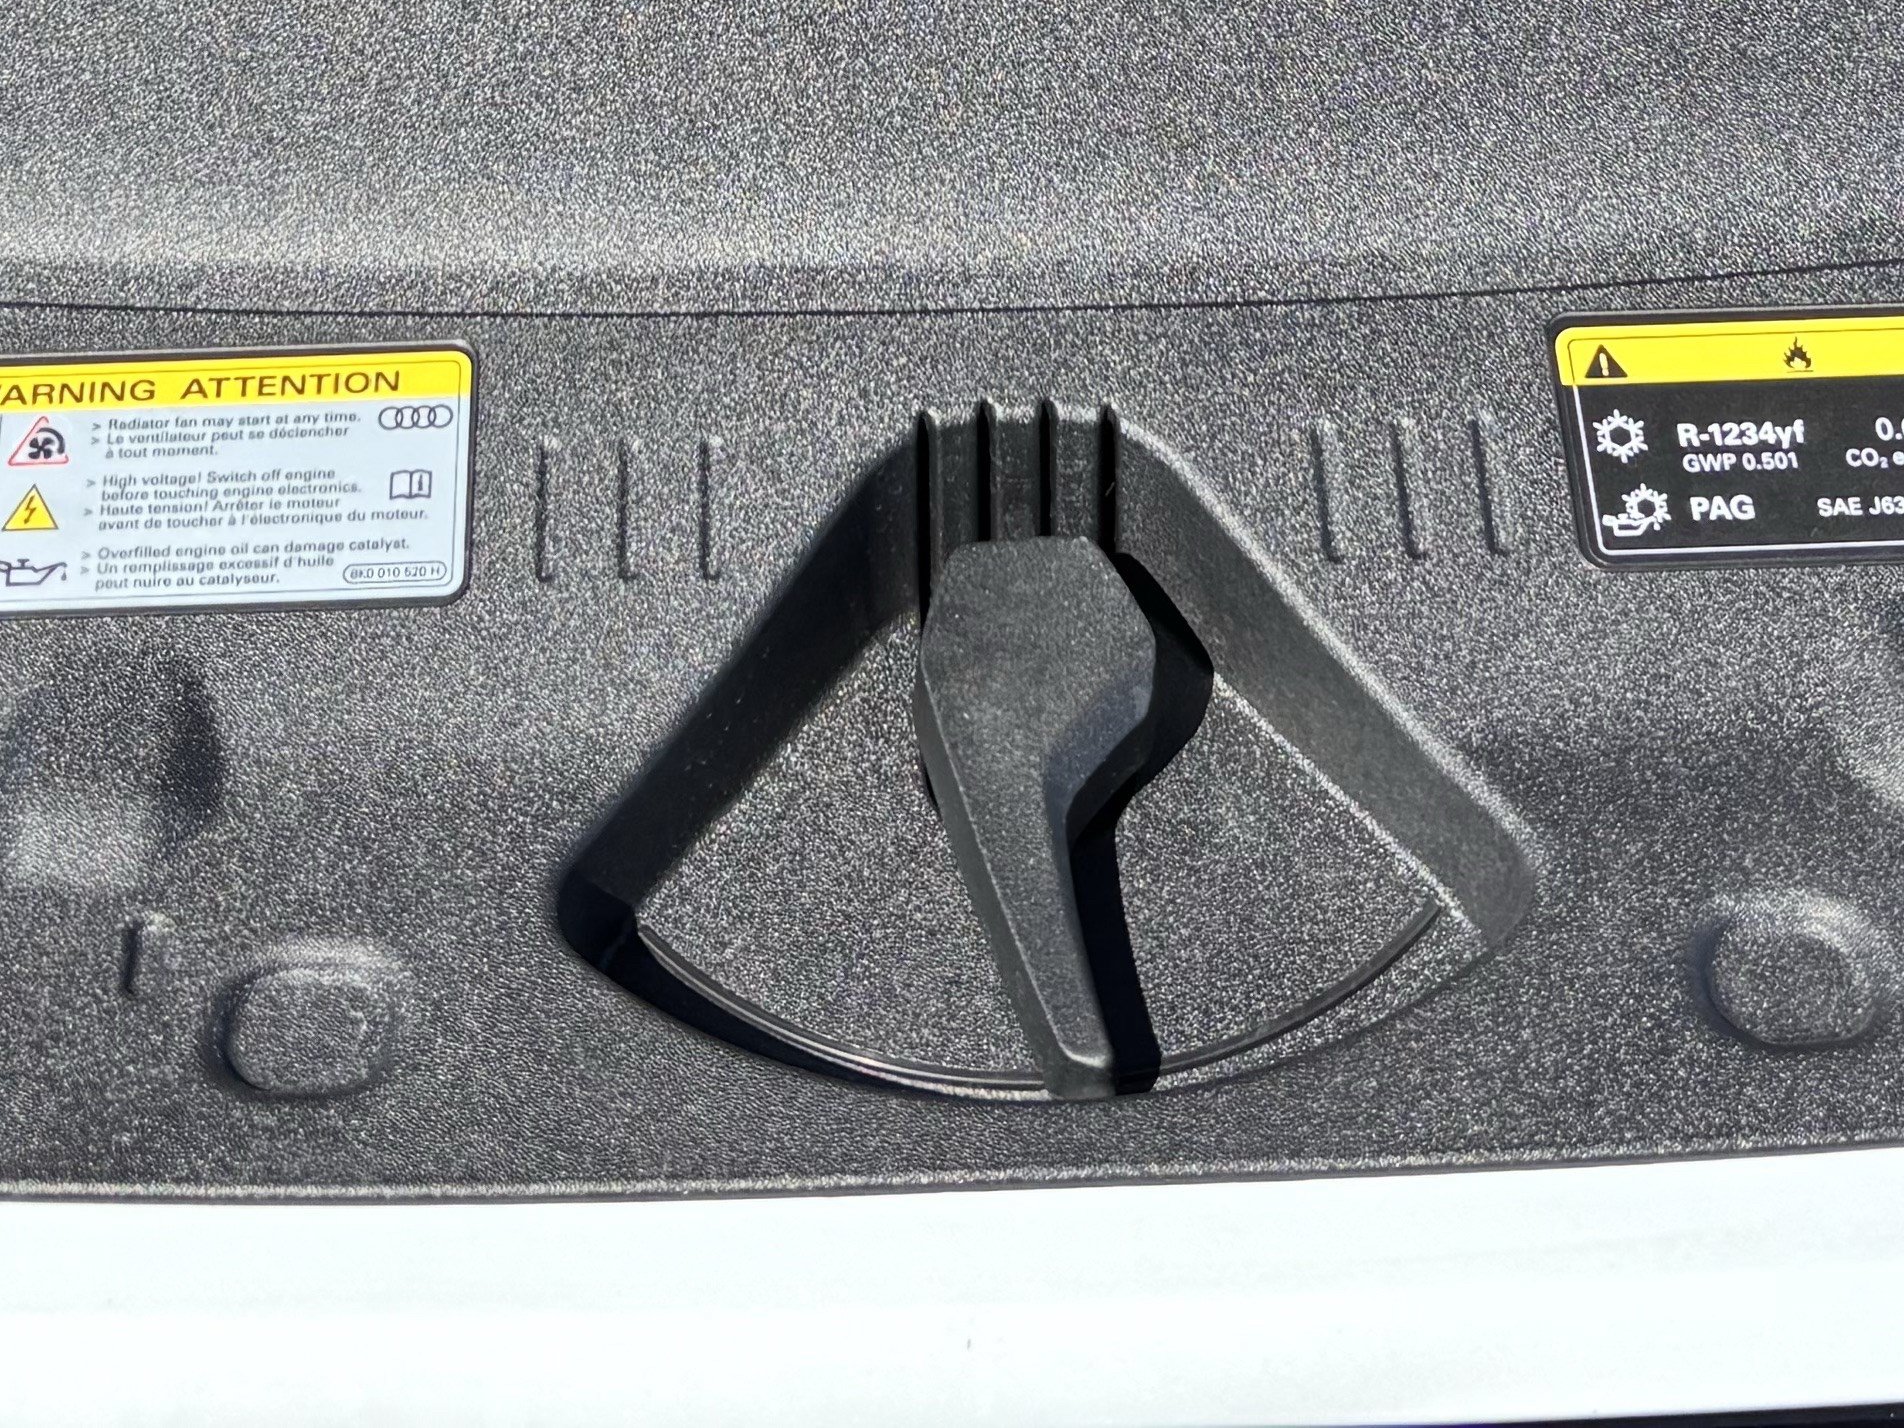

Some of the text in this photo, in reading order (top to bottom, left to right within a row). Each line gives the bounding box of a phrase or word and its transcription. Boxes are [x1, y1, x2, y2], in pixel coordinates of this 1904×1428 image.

[180, 370, 400, 400] ATTENTION
[109, 412, 361, 430] Radiator fan may start at any time.
[107, 426, 349, 445] Le ventilateur peut se déclencher
[1676, 418, 1805, 449] R-1234yf
[119, 448, 147, 459] tout
[152, 446, 218, 457] moment.
[1682, 451, 1799, 473] GWP 0.501
[103, 469, 335, 489] High voltage! Switch off engine
[102, 483, 362, 501] before touching engine electronics.
[100, 498, 340, 516] Haute tension! Arrêter le moteur
[1689, 494, 1756, 521] PAG
[1817, 496, 1863, 517] SAE
[98, 519, 139, 531] avant
[144, 517, 162, 529] de
[167, 515, 223, 528] toucher
[347, 509, 366, 521] du
[371, 509, 428, 520] moteur.
[98, 538, 409, 560] Overfilled engine oil can damage catalyst.
[97, 555, 334, 576] Un remplissage excessif d'huile
[378, 567, 400, 578] 010
[95, 572, 280, 592] peut nuire au catalyseur.
